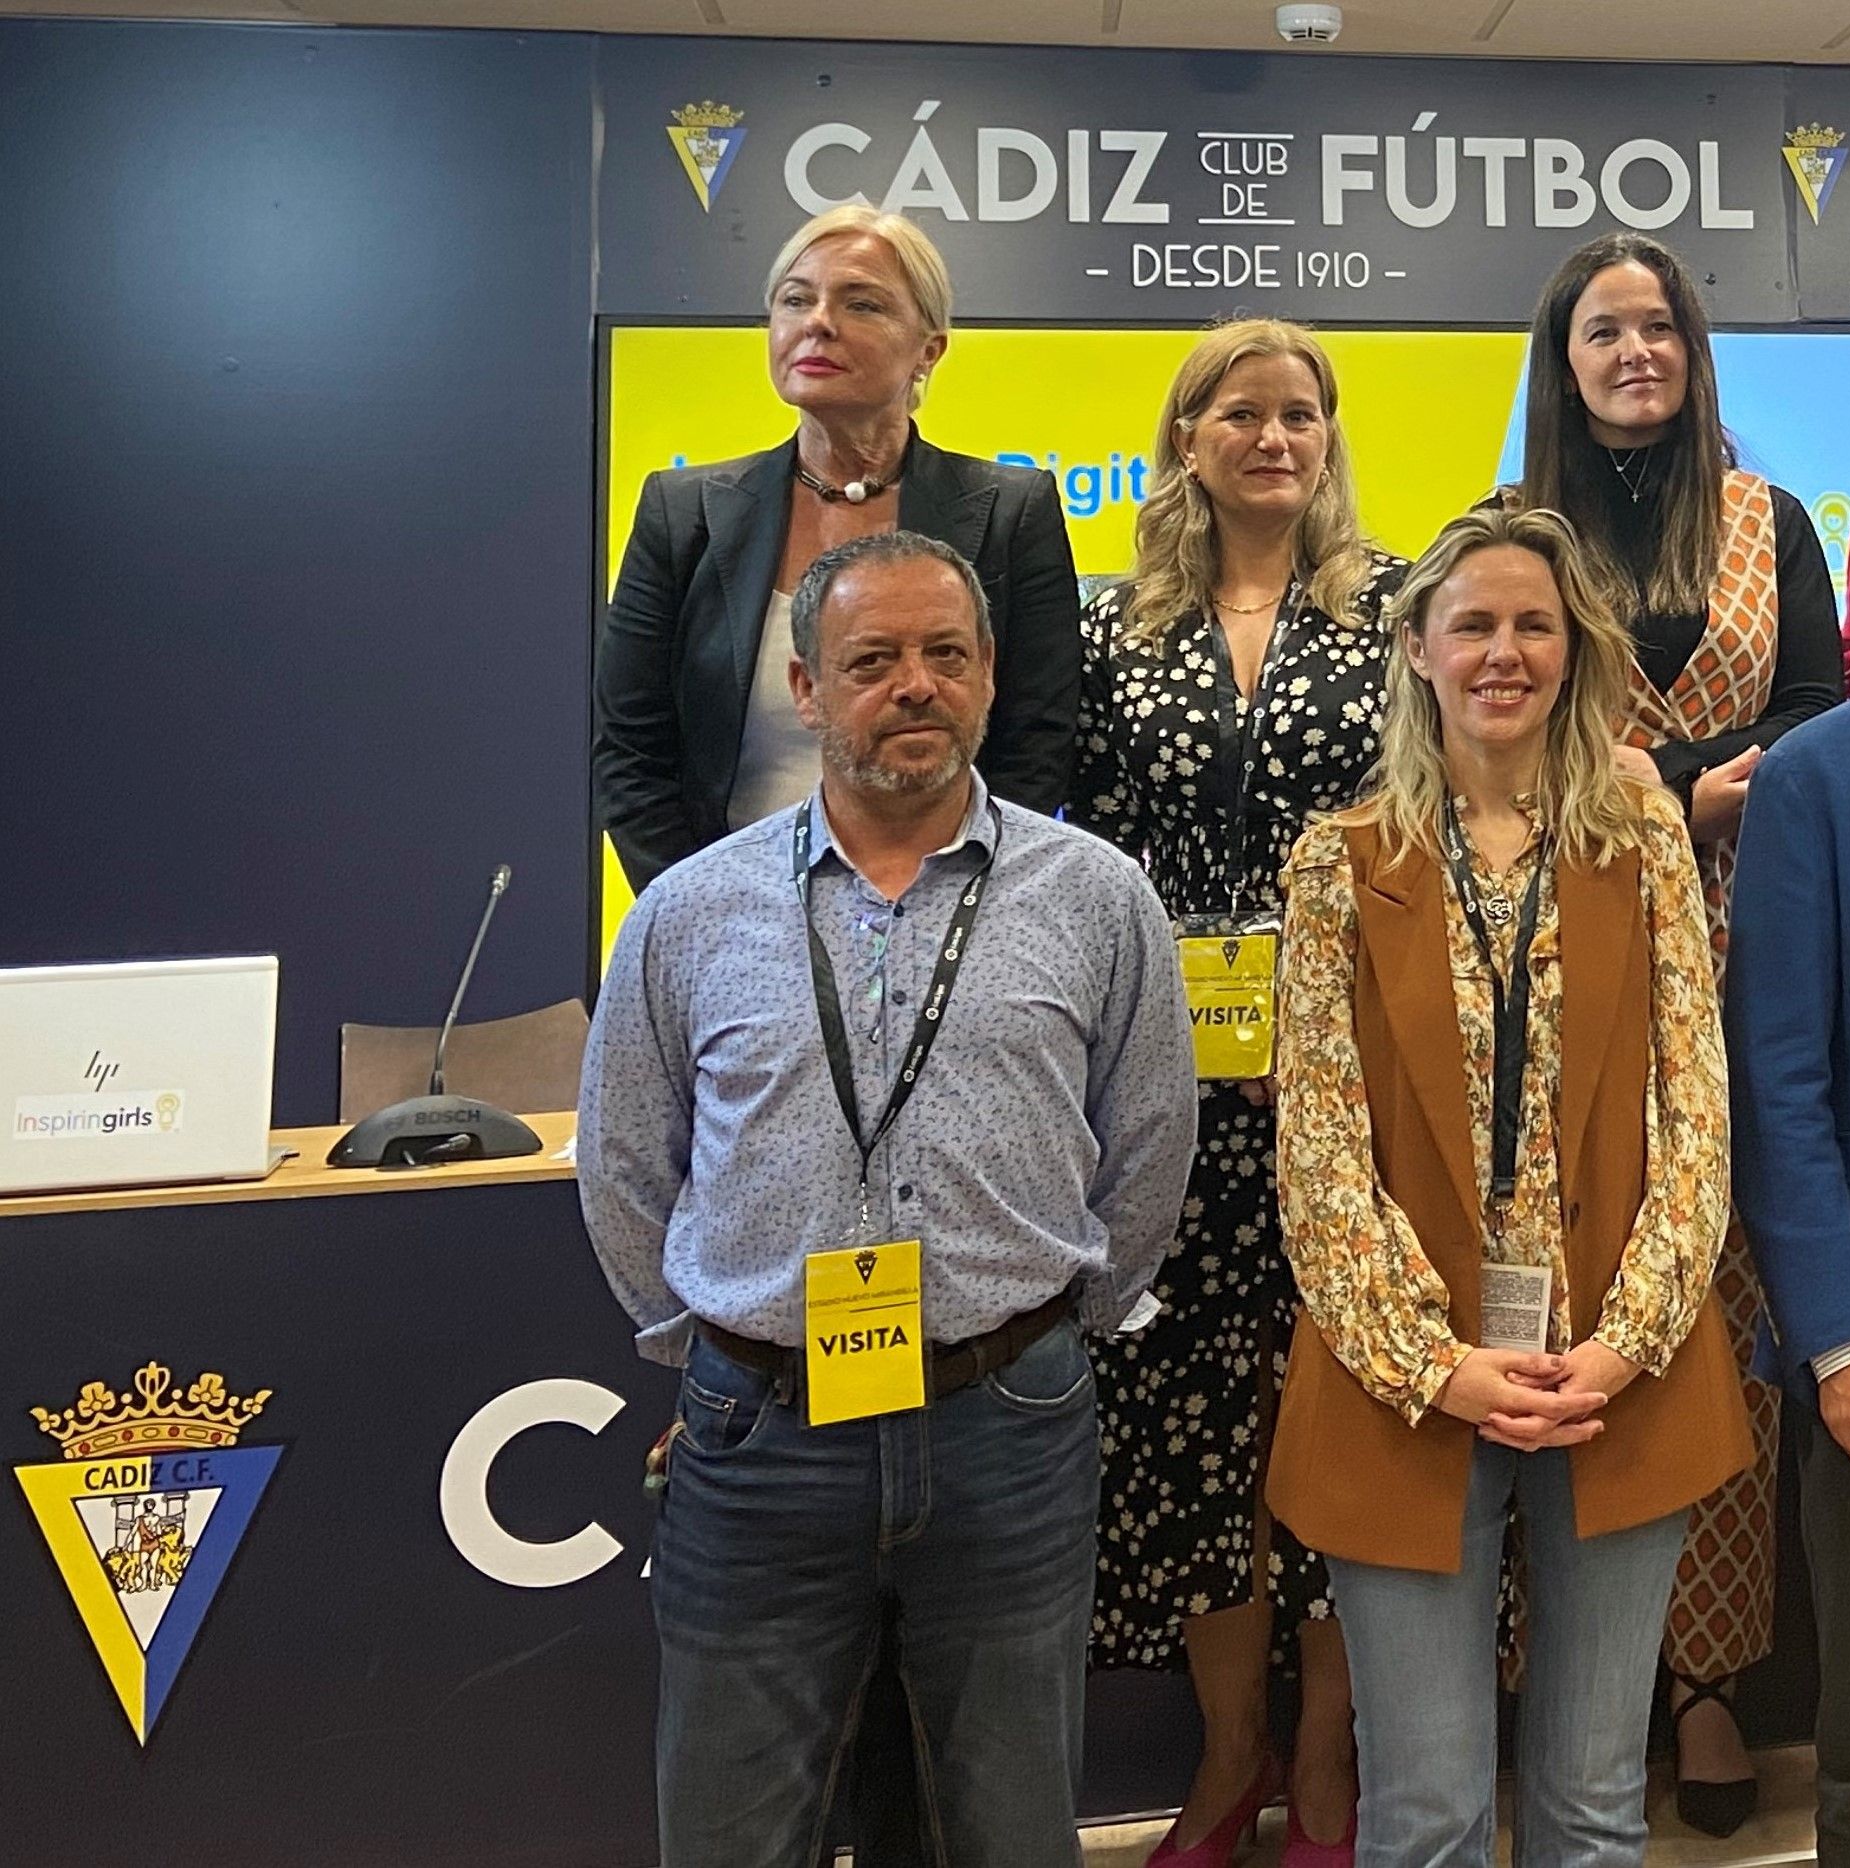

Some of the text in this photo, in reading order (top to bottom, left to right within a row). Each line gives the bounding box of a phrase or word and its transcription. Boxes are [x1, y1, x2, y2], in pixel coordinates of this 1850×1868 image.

[784, 101, 1170, 224] CÁDIZ
[1200, 141, 1288, 175] CLUB
[1321, 112, 1754, 230] FÚTBOL
[1222, 183, 1268, 217] DE
[1132, 244, 1371, 288] DESDE 1910
[1189, 1005, 1262, 1026] VISITA
[17, 1106, 153, 1136] Inspiringirls
[415, 1109, 481, 1125] BOSCH
[818, 1325, 910, 1357] VISITA
[84, 1458, 215, 1491] CADIZ C.F.
